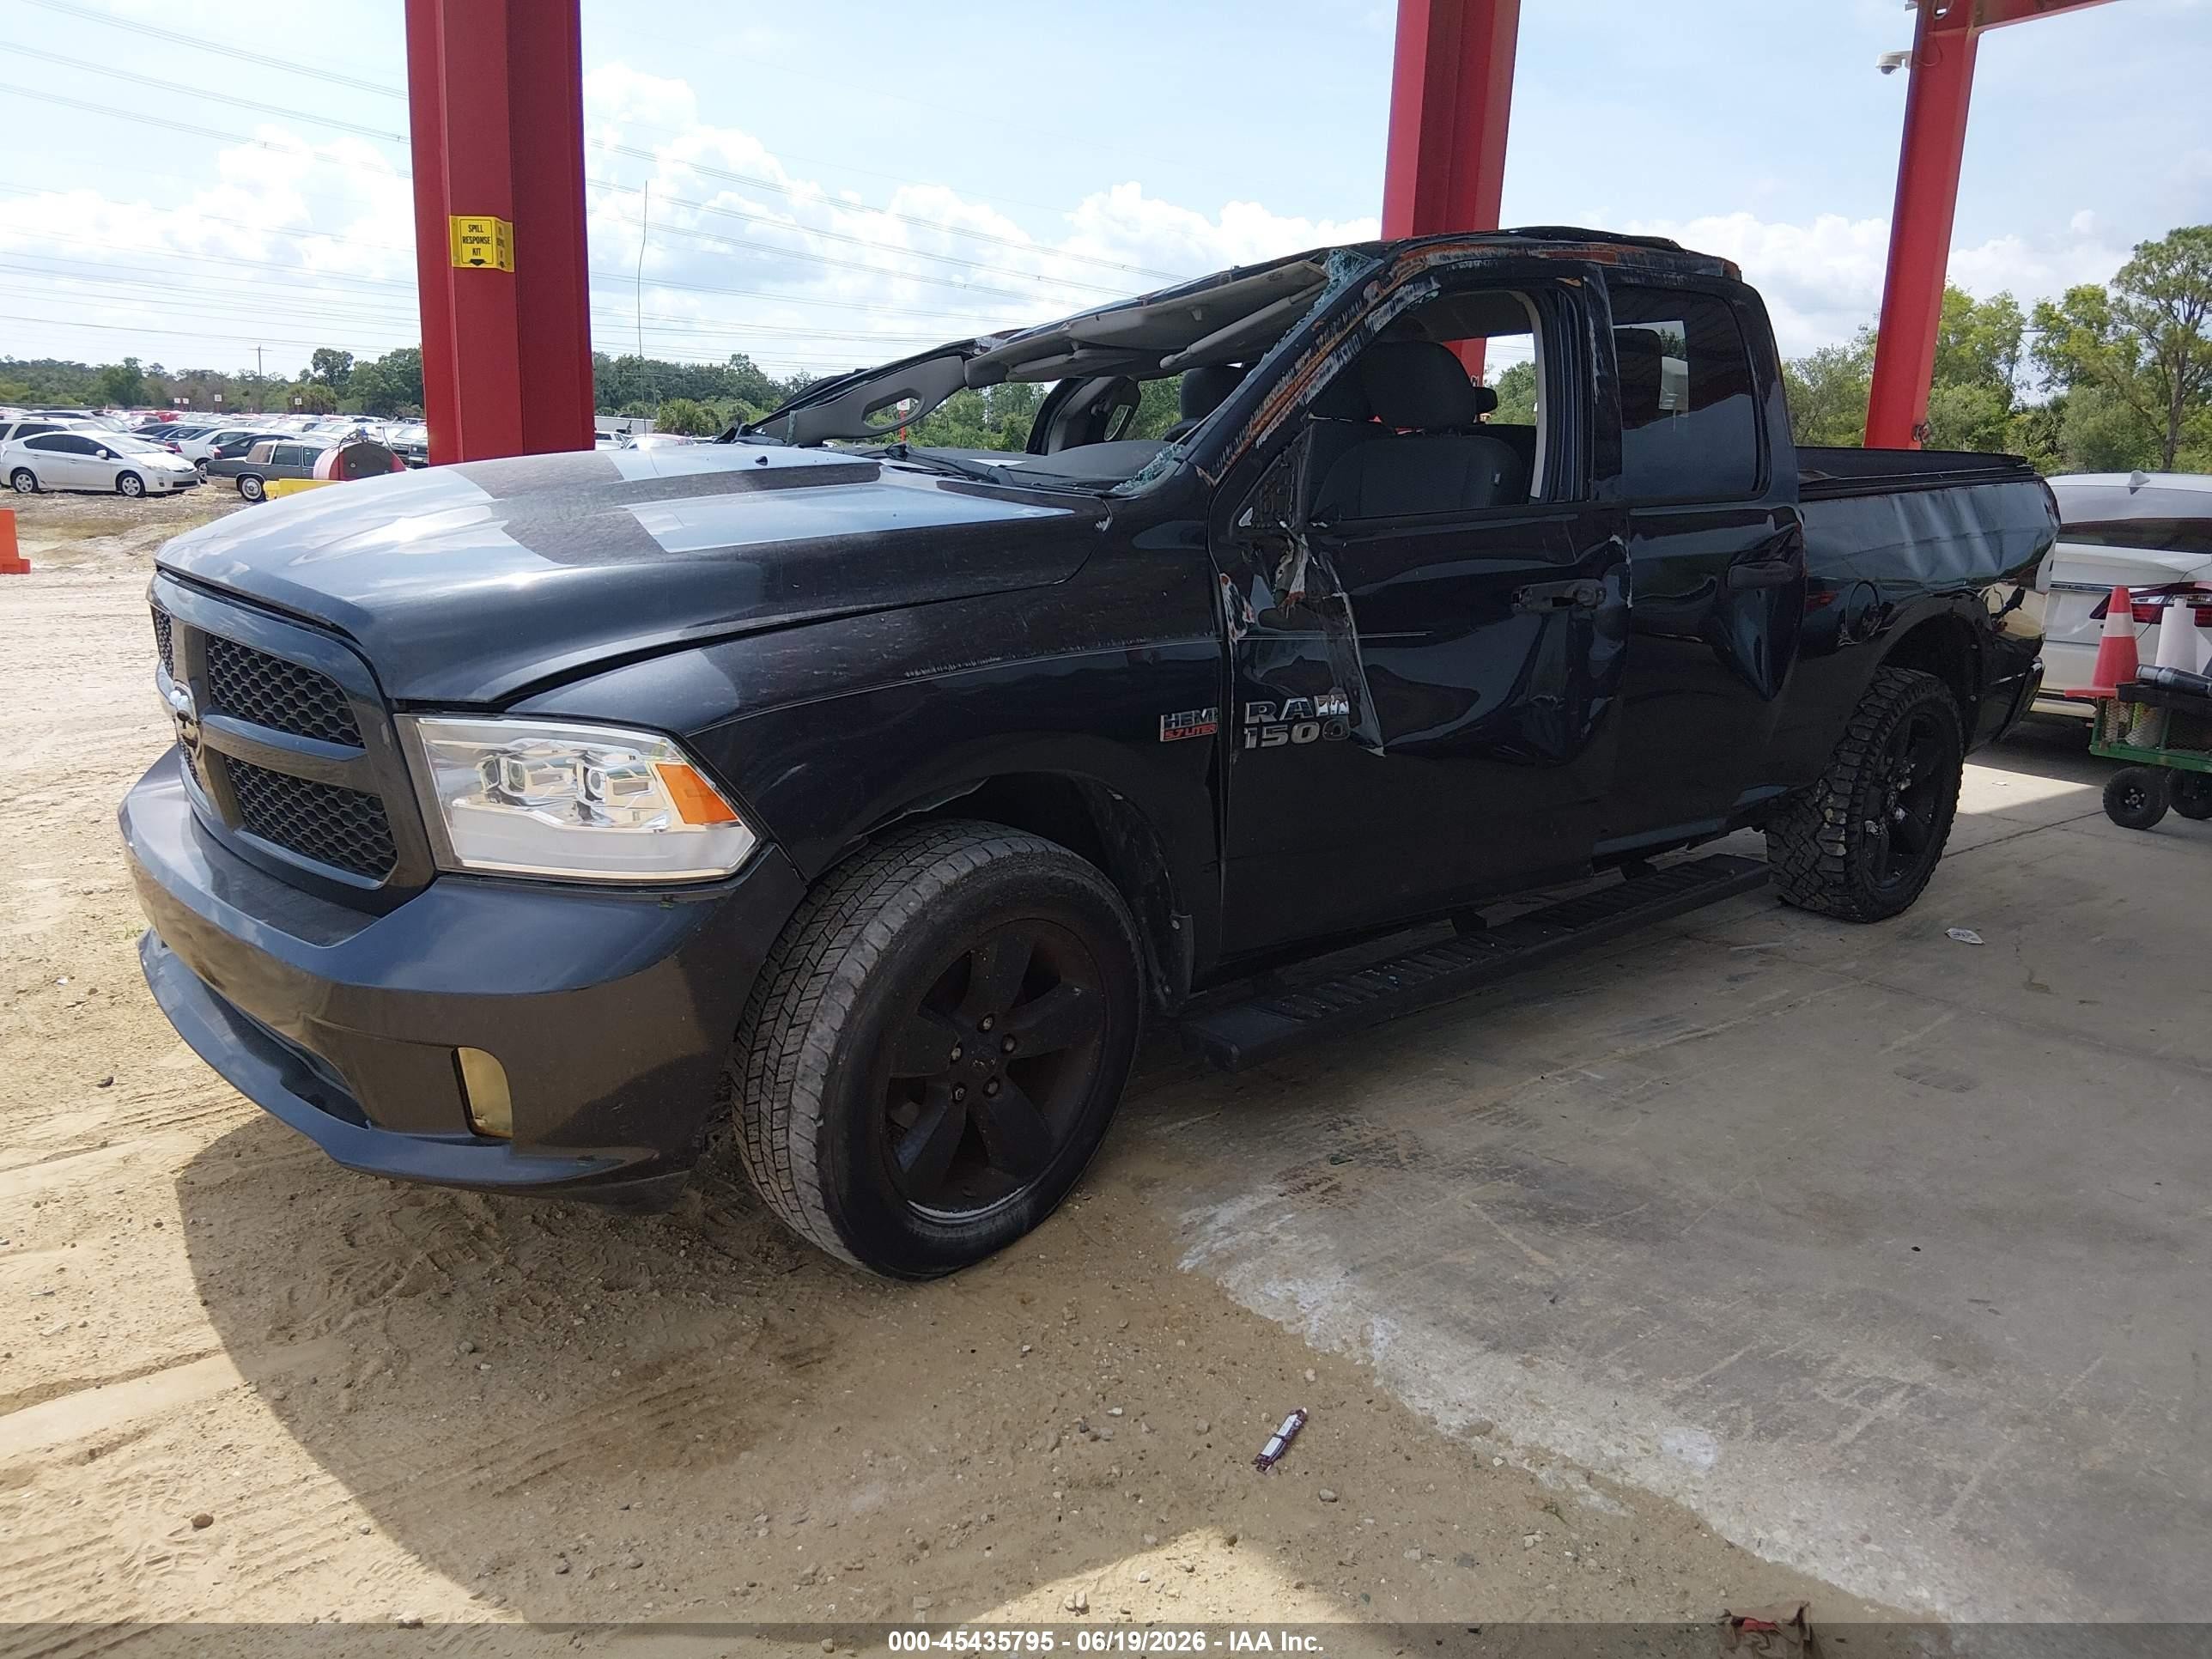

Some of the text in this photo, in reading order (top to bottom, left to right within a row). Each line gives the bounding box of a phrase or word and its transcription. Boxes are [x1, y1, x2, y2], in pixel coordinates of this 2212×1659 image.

[468, 224, 484, 233] SPILL
[462, 235, 491, 245] RESPONSE
[472, 247, 482, 257] KIT
[1244, 693, 1350, 724] RAM
[1160, 707, 1218, 730] HEMI
[1184, 723, 1218, 736] LITER
[1243, 720, 1352, 749] 1500
